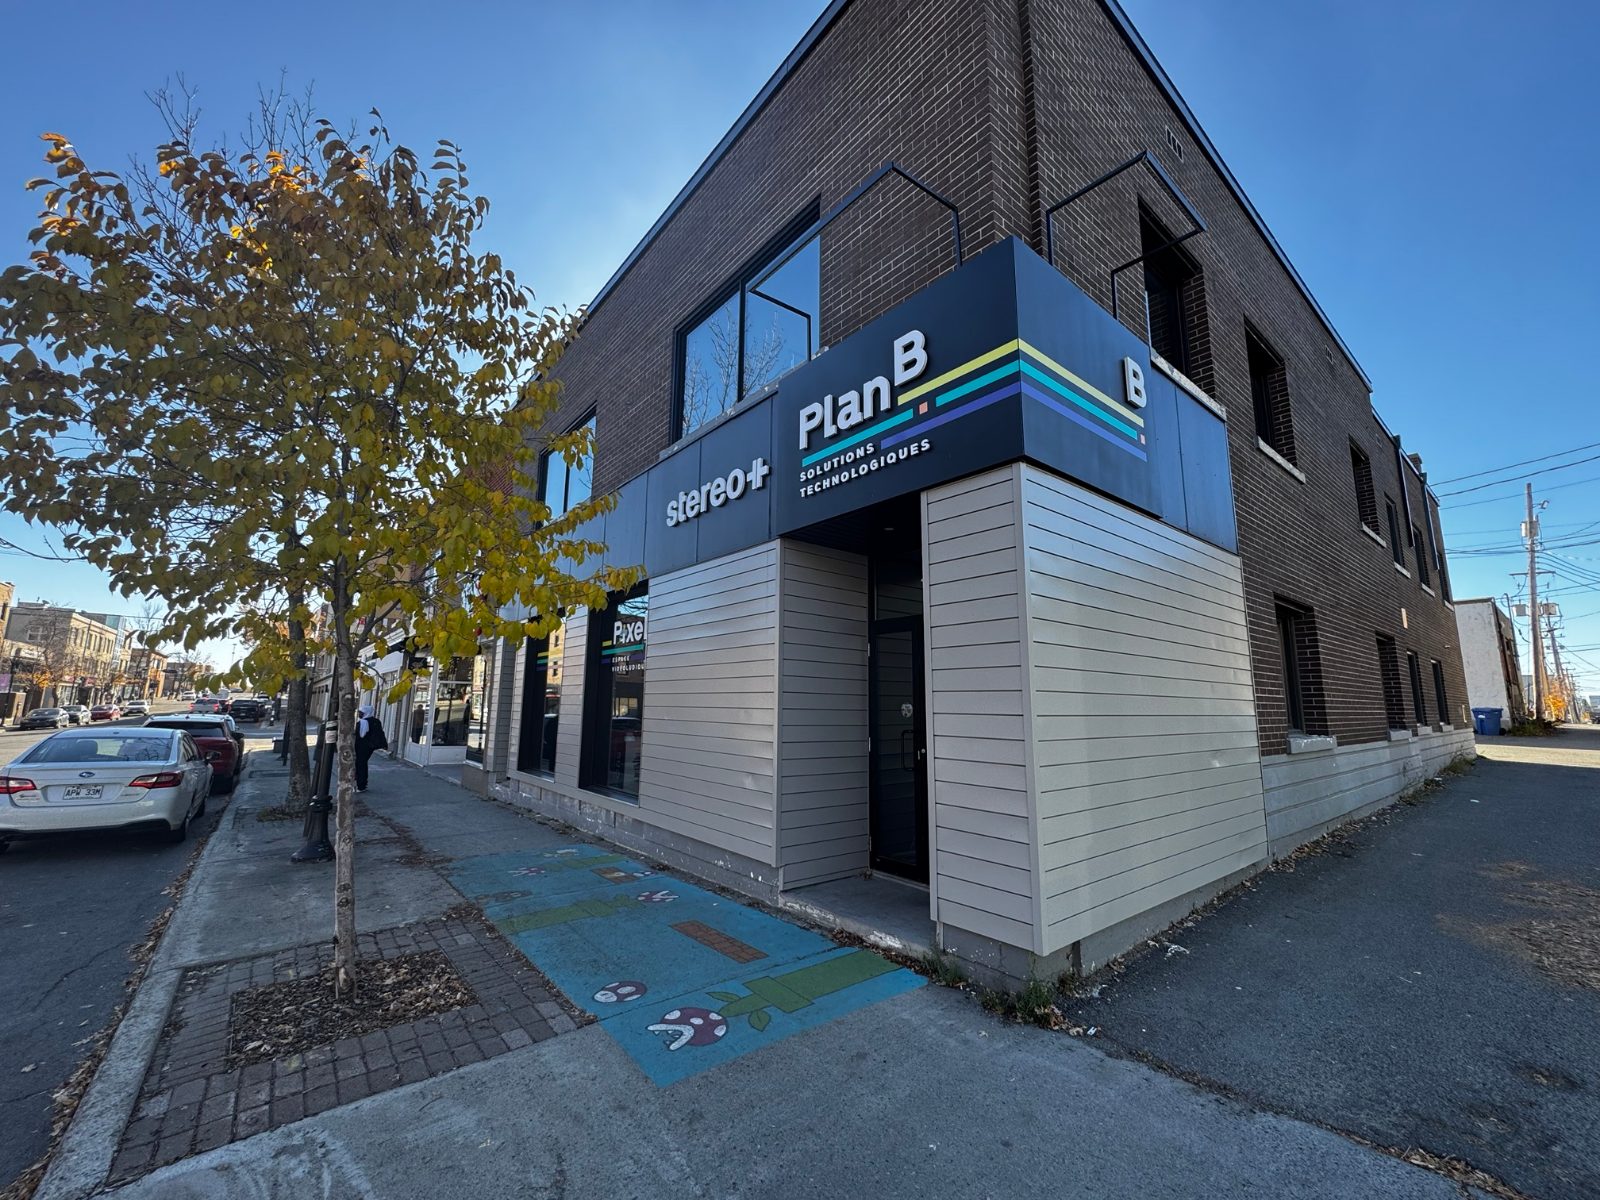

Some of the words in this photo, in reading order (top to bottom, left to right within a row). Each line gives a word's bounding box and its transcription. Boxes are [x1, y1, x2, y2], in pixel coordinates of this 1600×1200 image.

[799, 376, 891, 450] Plan
[893, 330, 928, 387] B
[1124, 356, 1147, 408] B
[799, 442, 875, 482] SOLUTIONS
[799, 439, 931, 498] TECHNOLOGIQUES
[613, 616, 648, 645] Pixel
